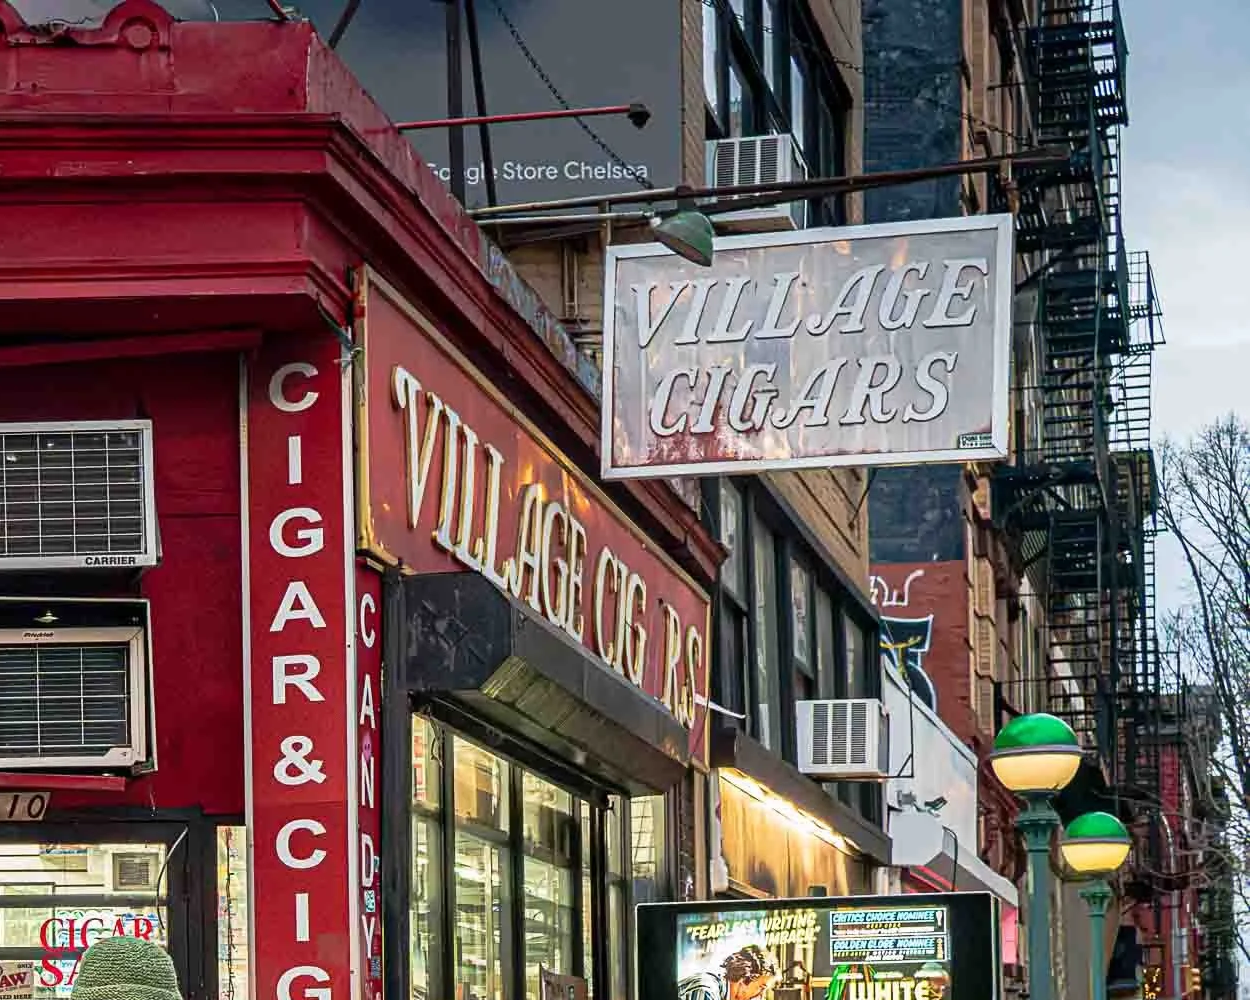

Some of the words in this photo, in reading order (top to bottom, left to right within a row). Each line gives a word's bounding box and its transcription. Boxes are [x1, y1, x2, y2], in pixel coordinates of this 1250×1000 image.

[502, 161, 558, 180] Store
[564, 161, 648, 180] Chelsea
[631, 258, 990, 350] VILLAGE
[650, 351, 959, 437] CIGARS
[391, 366, 587, 645] VILLAGE
[85, 556, 136, 566] CARRIER
[359, 593, 377, 960] CANDY
[897, 910, 935, 921] NOMINEE
[896, 938, 935, 948] NOMINEE
